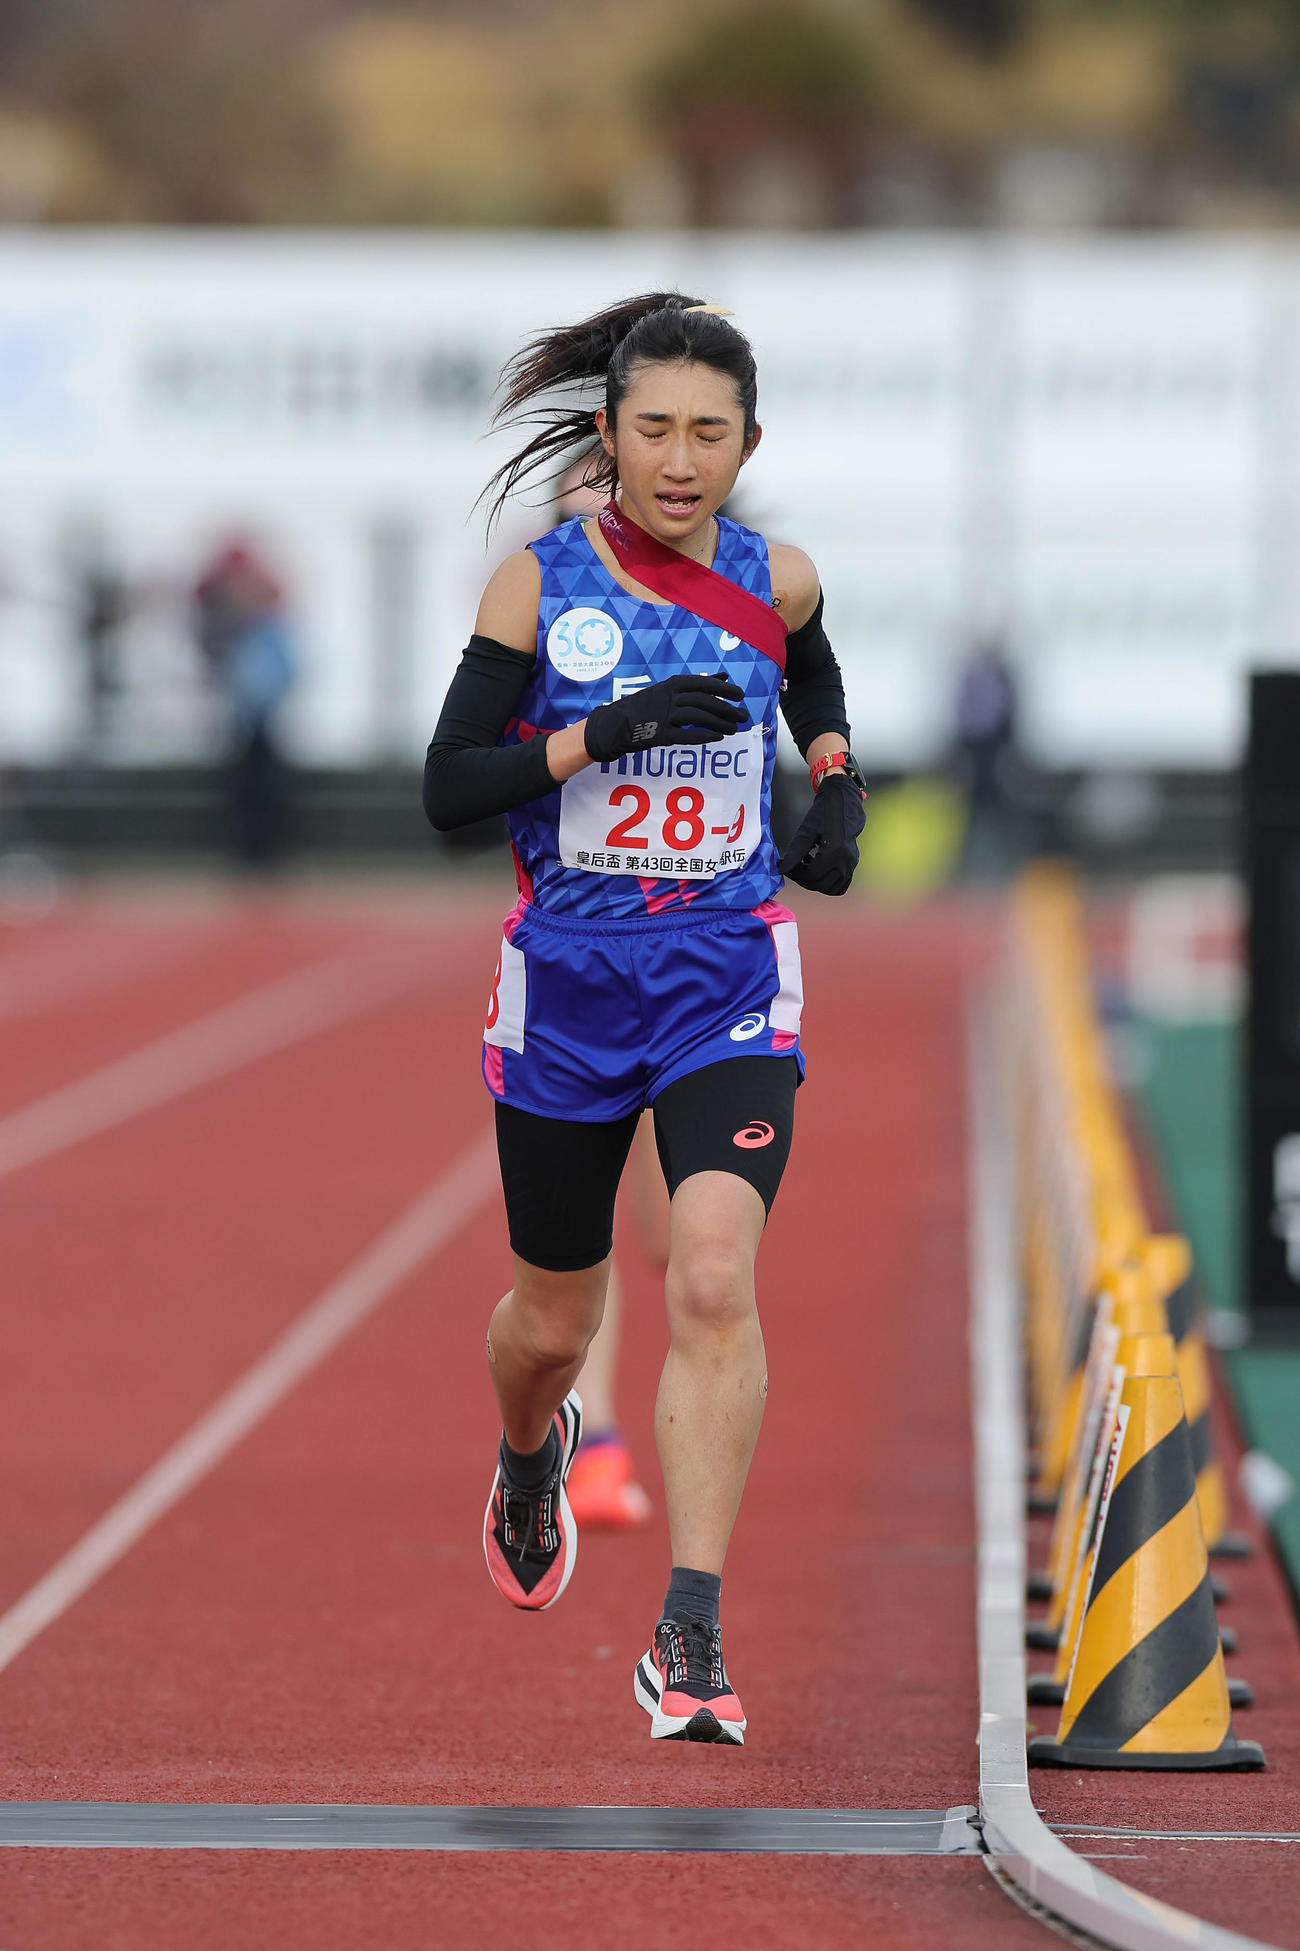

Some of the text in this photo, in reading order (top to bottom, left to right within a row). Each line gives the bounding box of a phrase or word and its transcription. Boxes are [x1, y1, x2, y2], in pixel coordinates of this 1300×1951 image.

[557, 618, 615, 658] 30
[576, 848, 746, 873] 皇后盃 第43回全国女駅伝
